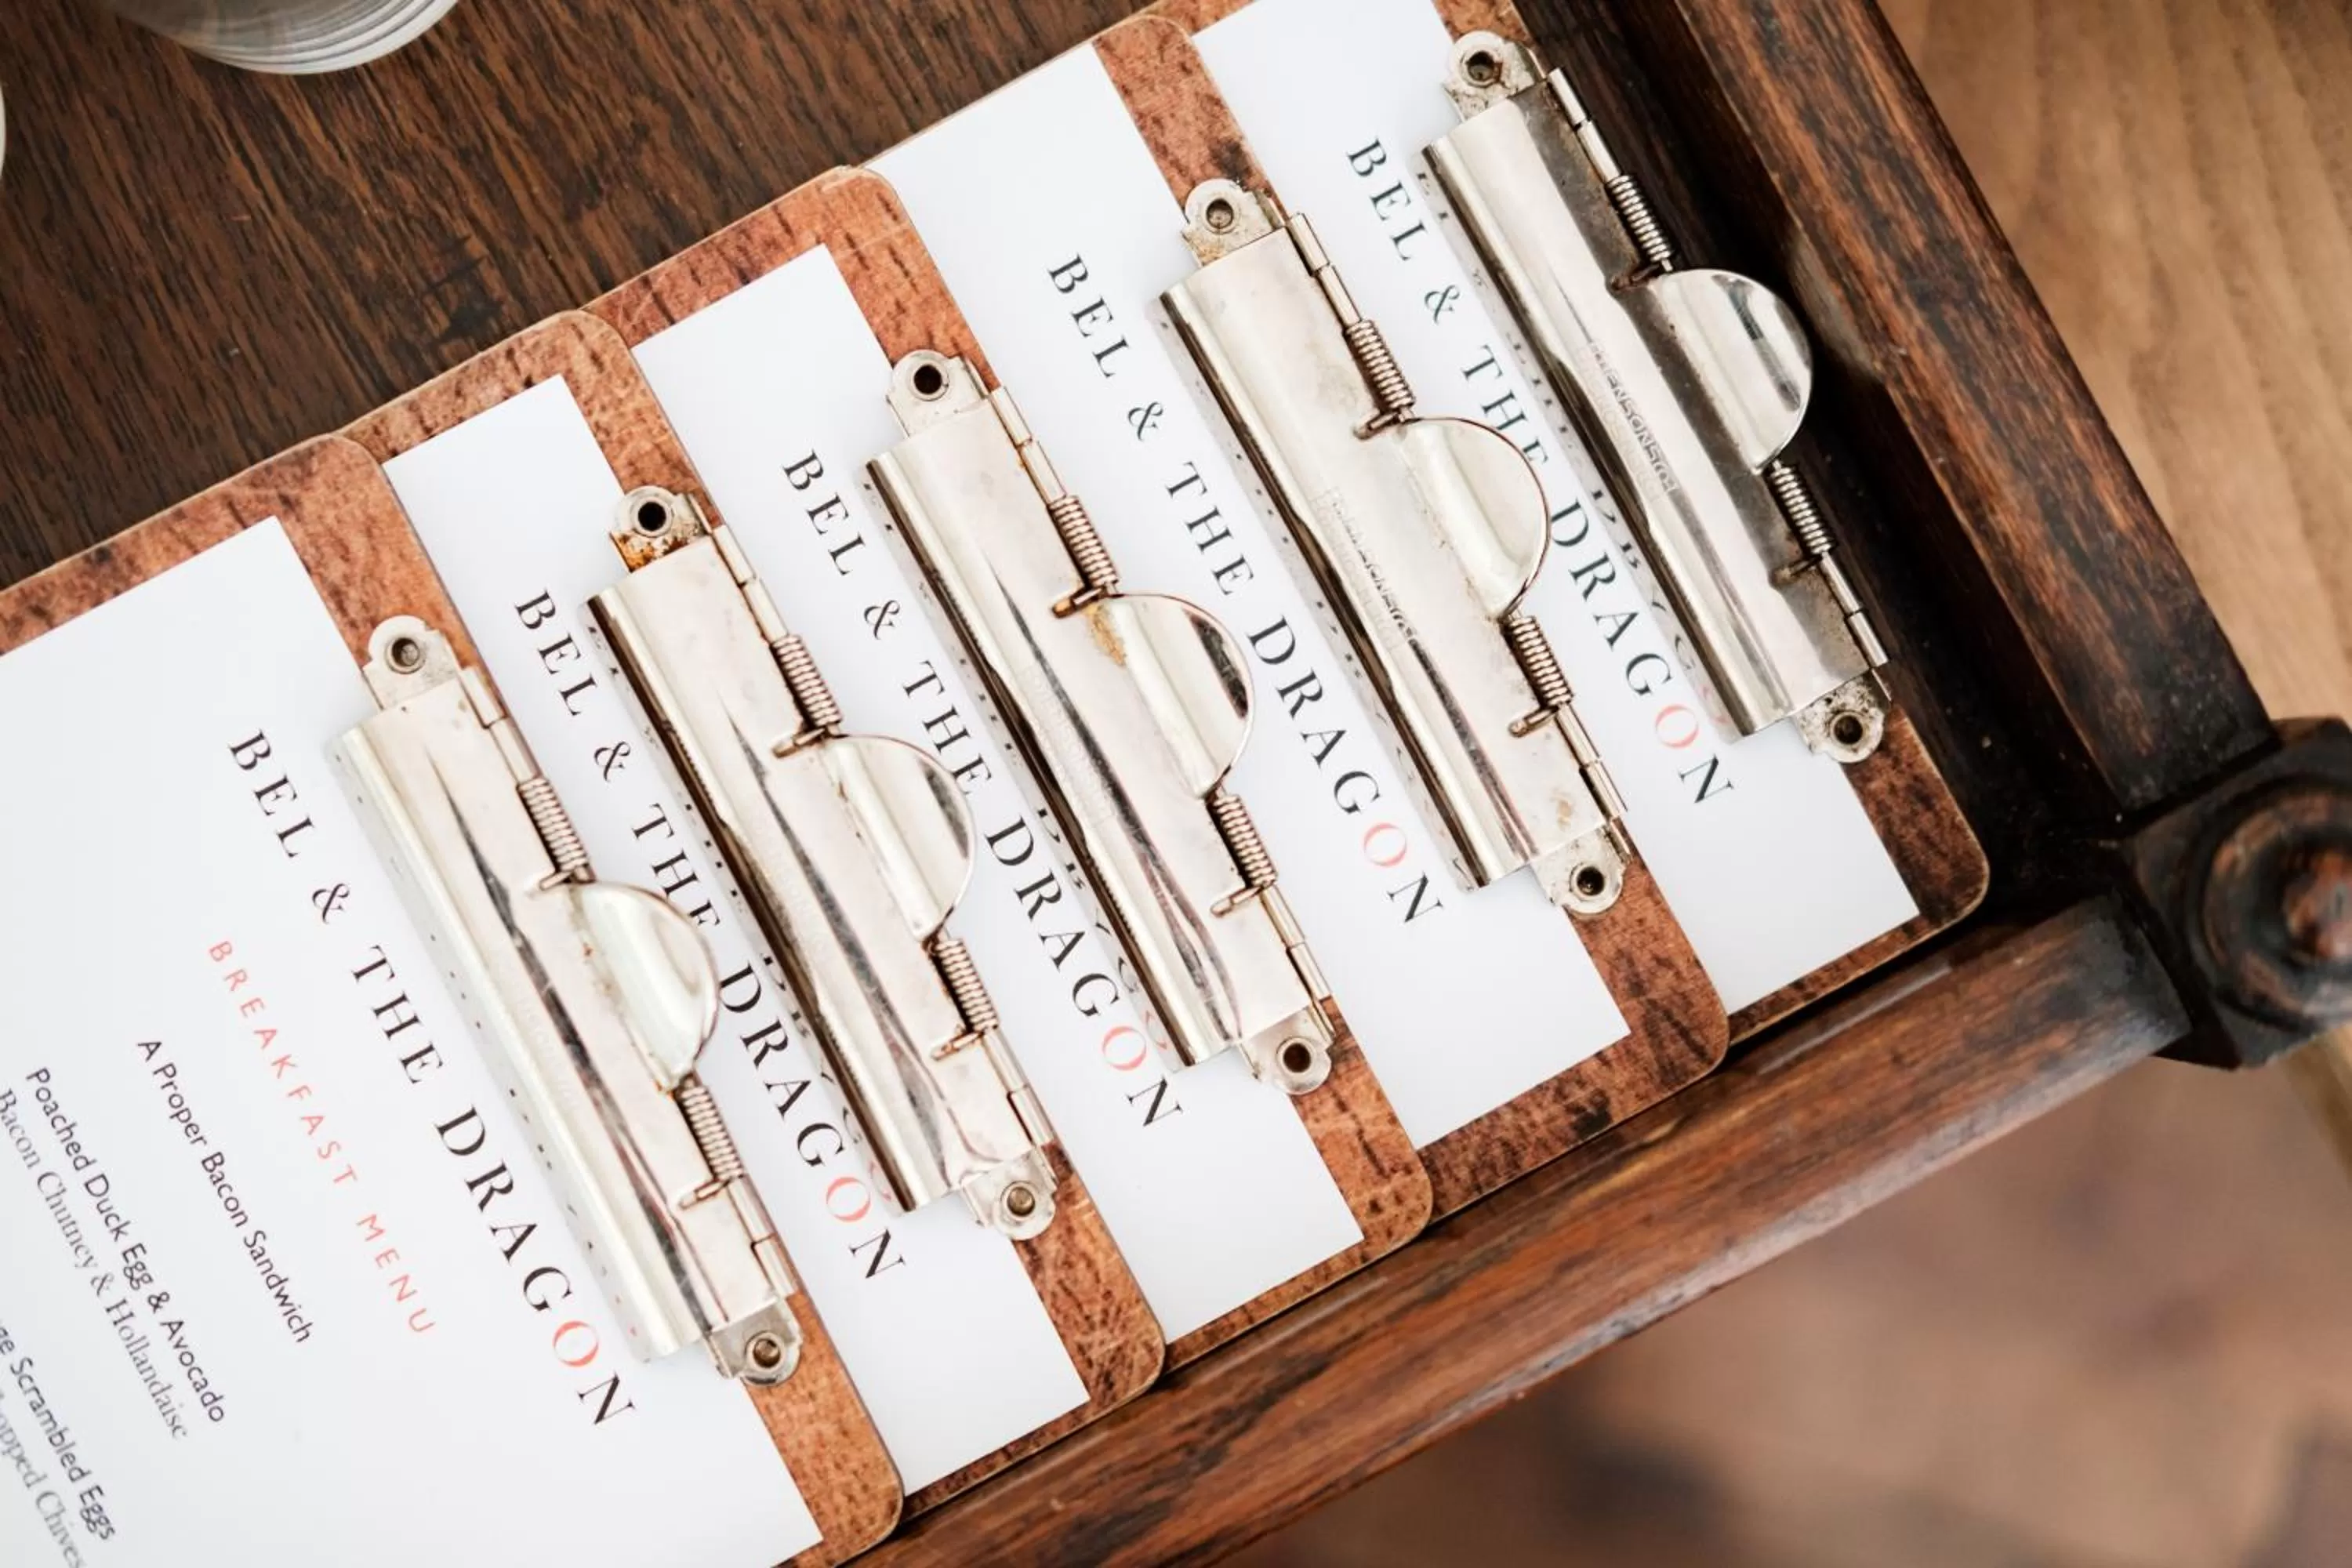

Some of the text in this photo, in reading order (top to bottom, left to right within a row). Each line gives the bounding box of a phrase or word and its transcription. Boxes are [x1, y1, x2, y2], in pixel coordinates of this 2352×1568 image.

[1048, 254, 1128, 378] BEL
[1127, 402, 1163, 441] &
[1167, 462, 1254, 595] THE
[1247, 615, 1443, 923] DRAGON
[1348, 139, 1425, 261] BEL
[1425, 285, 1459, 322] &
[1551, 499, 1733, 803] DRAGON
[515, 590, 597, 716] BEL
[593, 742, 630, 781] &
[719, 961, 905, 1279] DRAGON
[783, 450, 865, 575] BEL
[864, 601, 900, 640] &
[903, 660, 992, 795] THE
[985, 815, 1182, 1127] DRAGON
[0, 1088, 187, 1437] Bacon Chutney & Hollandaise
[26, 1068, 224, 1422] Poached Duck Egg & Avocado
[137, 1040, 314, 1342] A Proper Bacon Sandwich
[209, 941, 434, 1332] BREAKFAST MENU
[230, 730, 635, 1425] BEL & THE DRAGON
[9, 1357, 115, 1540] Scrambled Eggs
